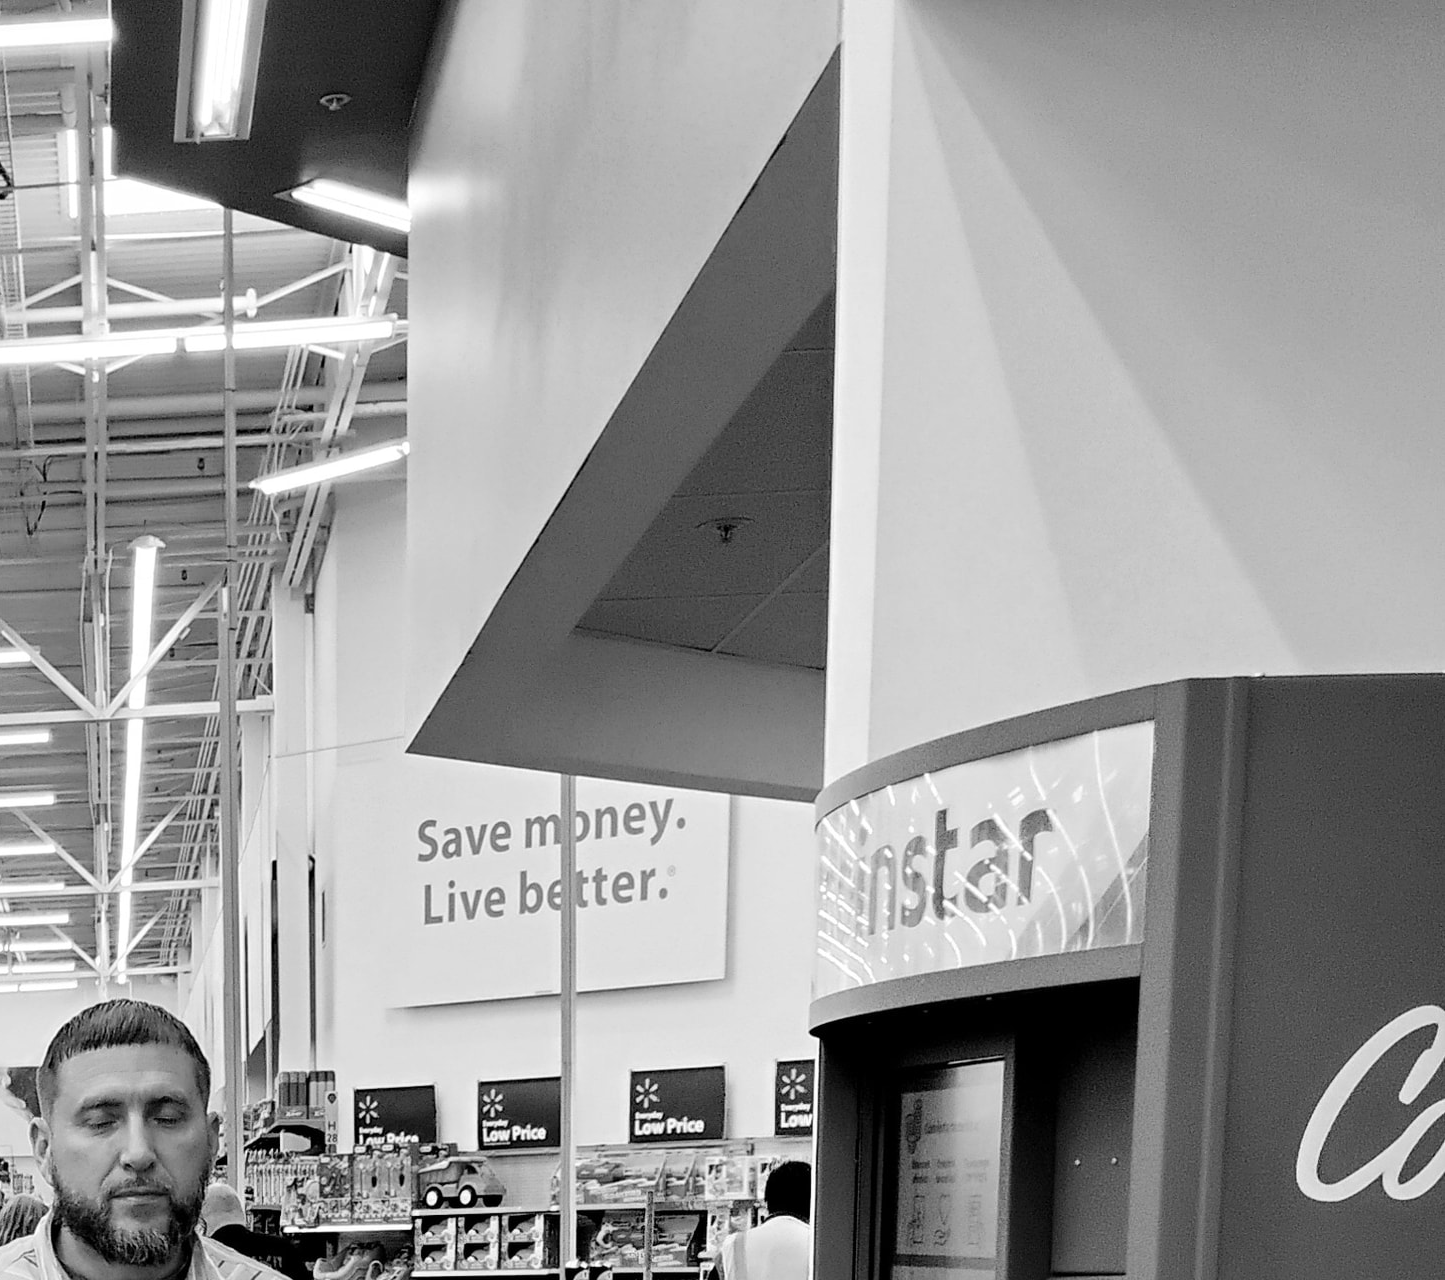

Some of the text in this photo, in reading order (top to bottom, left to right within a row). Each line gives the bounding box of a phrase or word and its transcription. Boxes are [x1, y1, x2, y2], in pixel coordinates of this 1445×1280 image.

[417, 798, 686, 862] Save money.
[424, 867, 668, 925] Live better.
[327, 1121, 337, 1131] H
[634, 1115, 705, 1136] Low Price
[780, 1111, 813, 1129] Low
[326, 1134, 338, 1143] 28
[482, 1123, 547, 1143] Low Price
